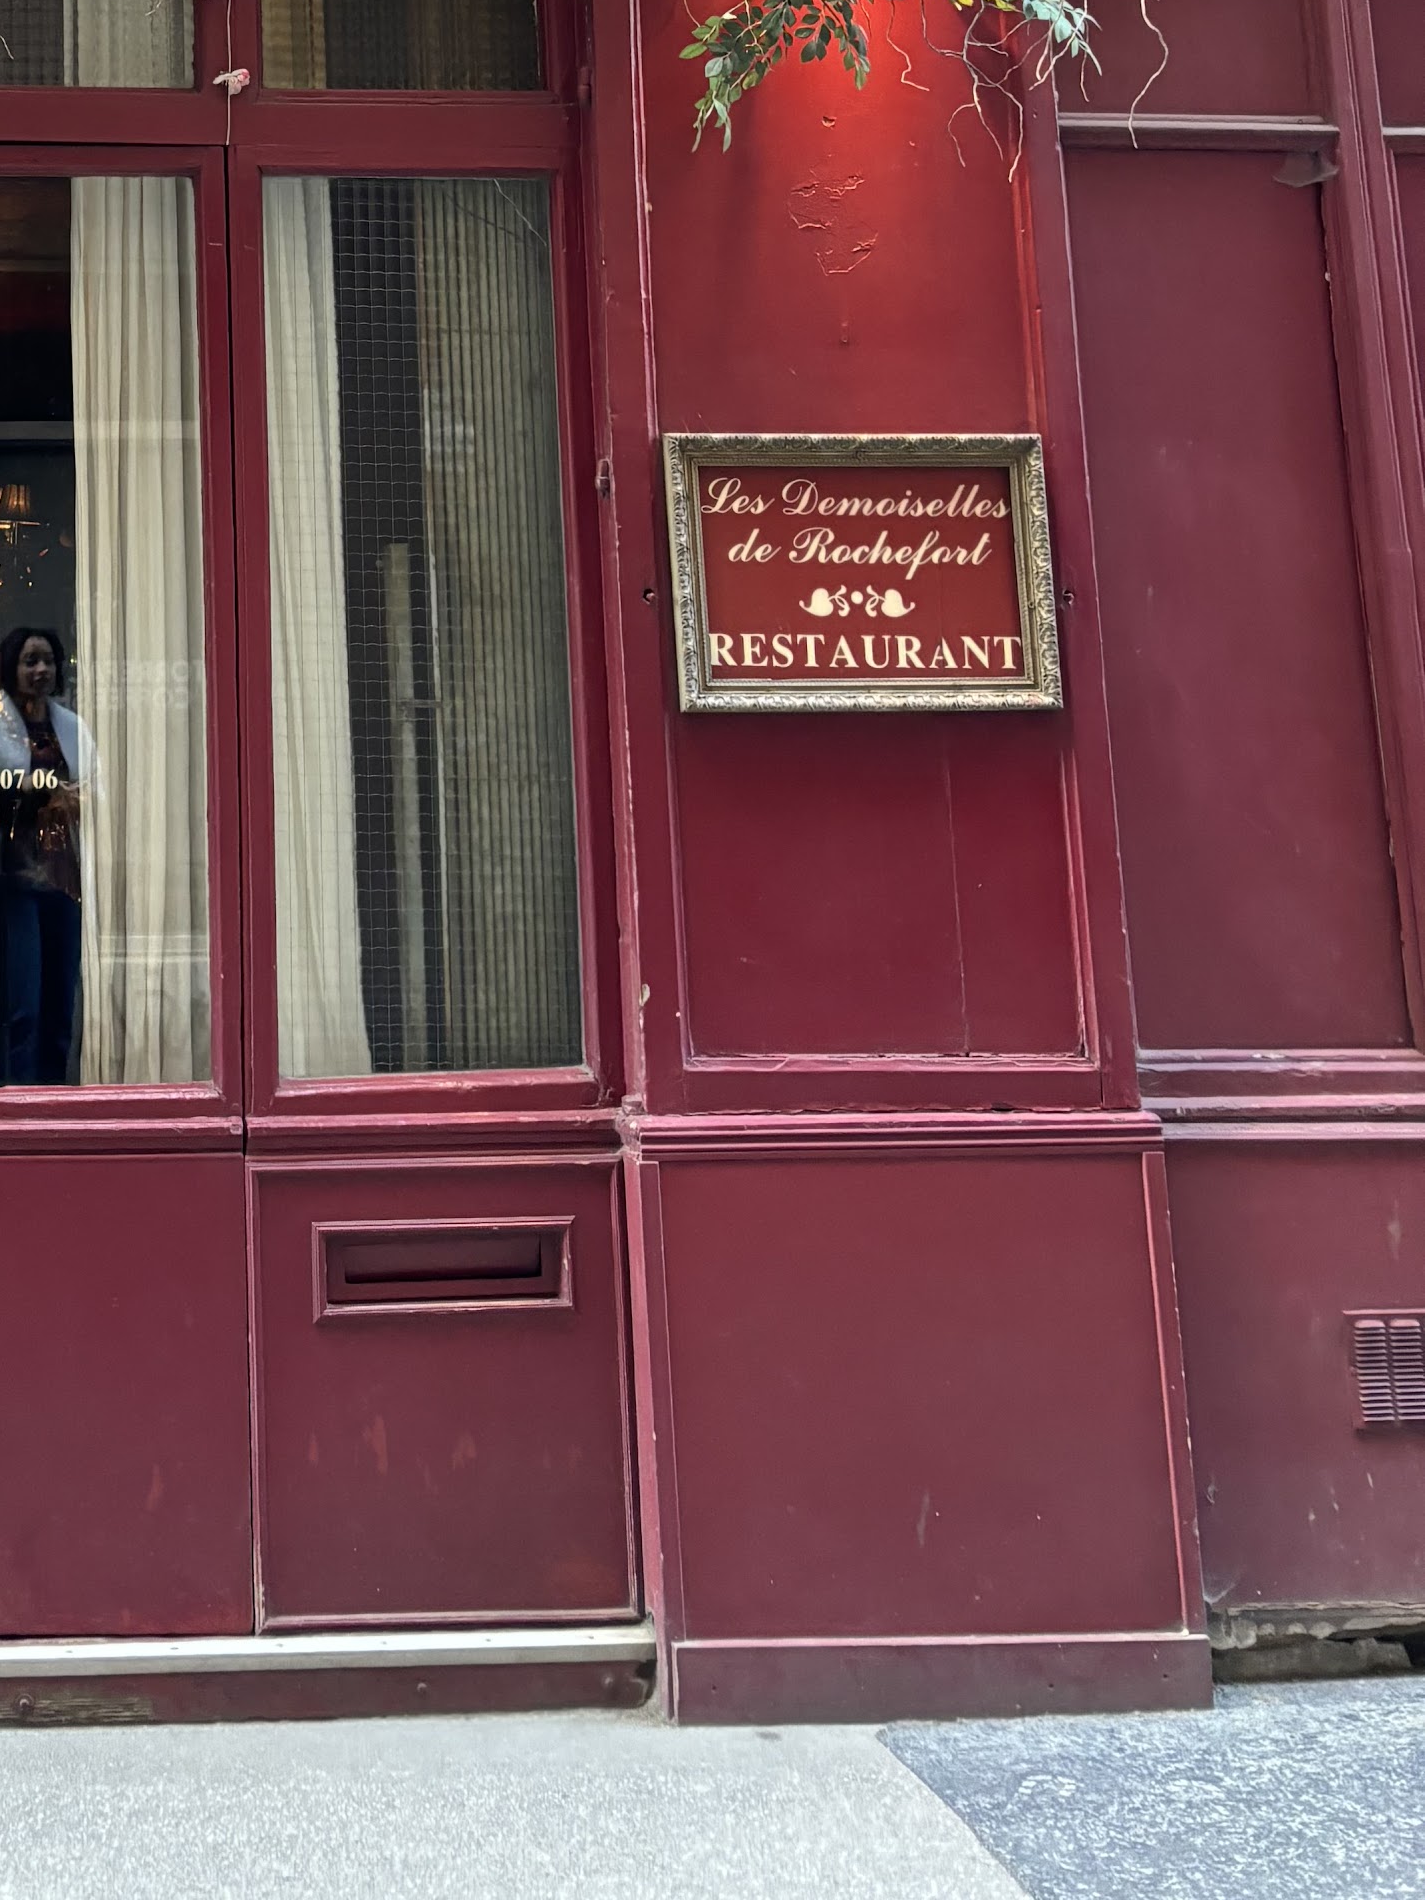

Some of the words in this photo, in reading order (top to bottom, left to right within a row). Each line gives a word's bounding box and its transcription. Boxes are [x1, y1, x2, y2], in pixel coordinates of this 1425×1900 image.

[701, 477, 775, 515] Les
[781, 479, 1010, 519] Demoiselles
[728, 528, 781, 563] de
[789, 527, 993, 580] Rochefort
[709, 633, 1022, 670] RESTAURANT
[0, 769, 26, 790] 07
[32, 769, 58, 790] 06
